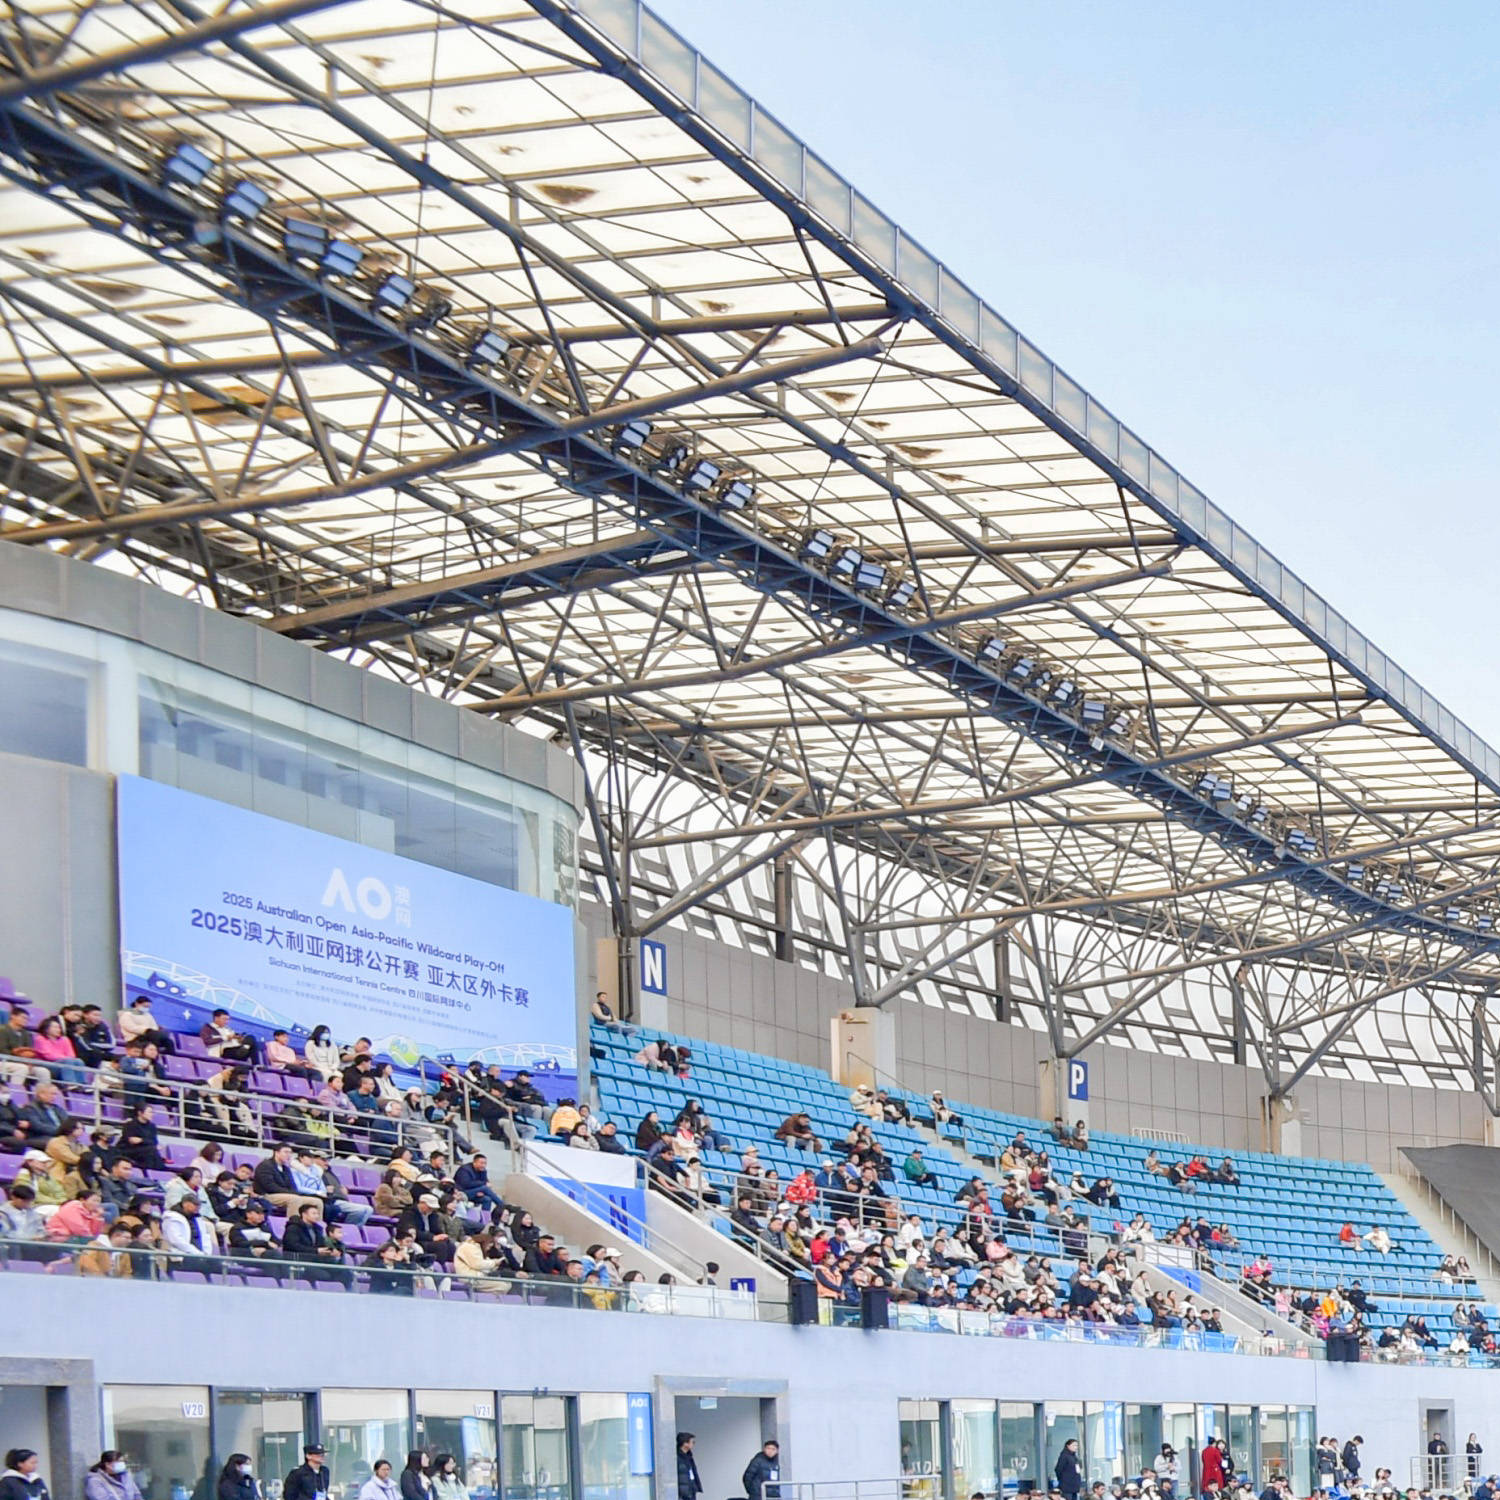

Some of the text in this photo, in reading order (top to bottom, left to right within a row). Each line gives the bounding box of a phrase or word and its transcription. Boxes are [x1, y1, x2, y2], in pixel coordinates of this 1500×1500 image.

[321, 867, 392, 920] AO
[222, 891, 505, 974] 2025 Australian Open Asia-Pacific Wildcard Play-Off
[191, 908, 419, 981] 2025澳大利亚网球公开赛
[427, 964, 529, 1008] 亚太区外卡赛
[268, 956, 301, 971] Sichuan
[303, 964, 353, 983] International
[355, 976, 378, 989] Tennis
[380, 982, 407, 995] Centre
[644, 944, 663, 990] N
[1071, 1063, 1084, 1096] P
[183, 1402, 205, 1416] V20
